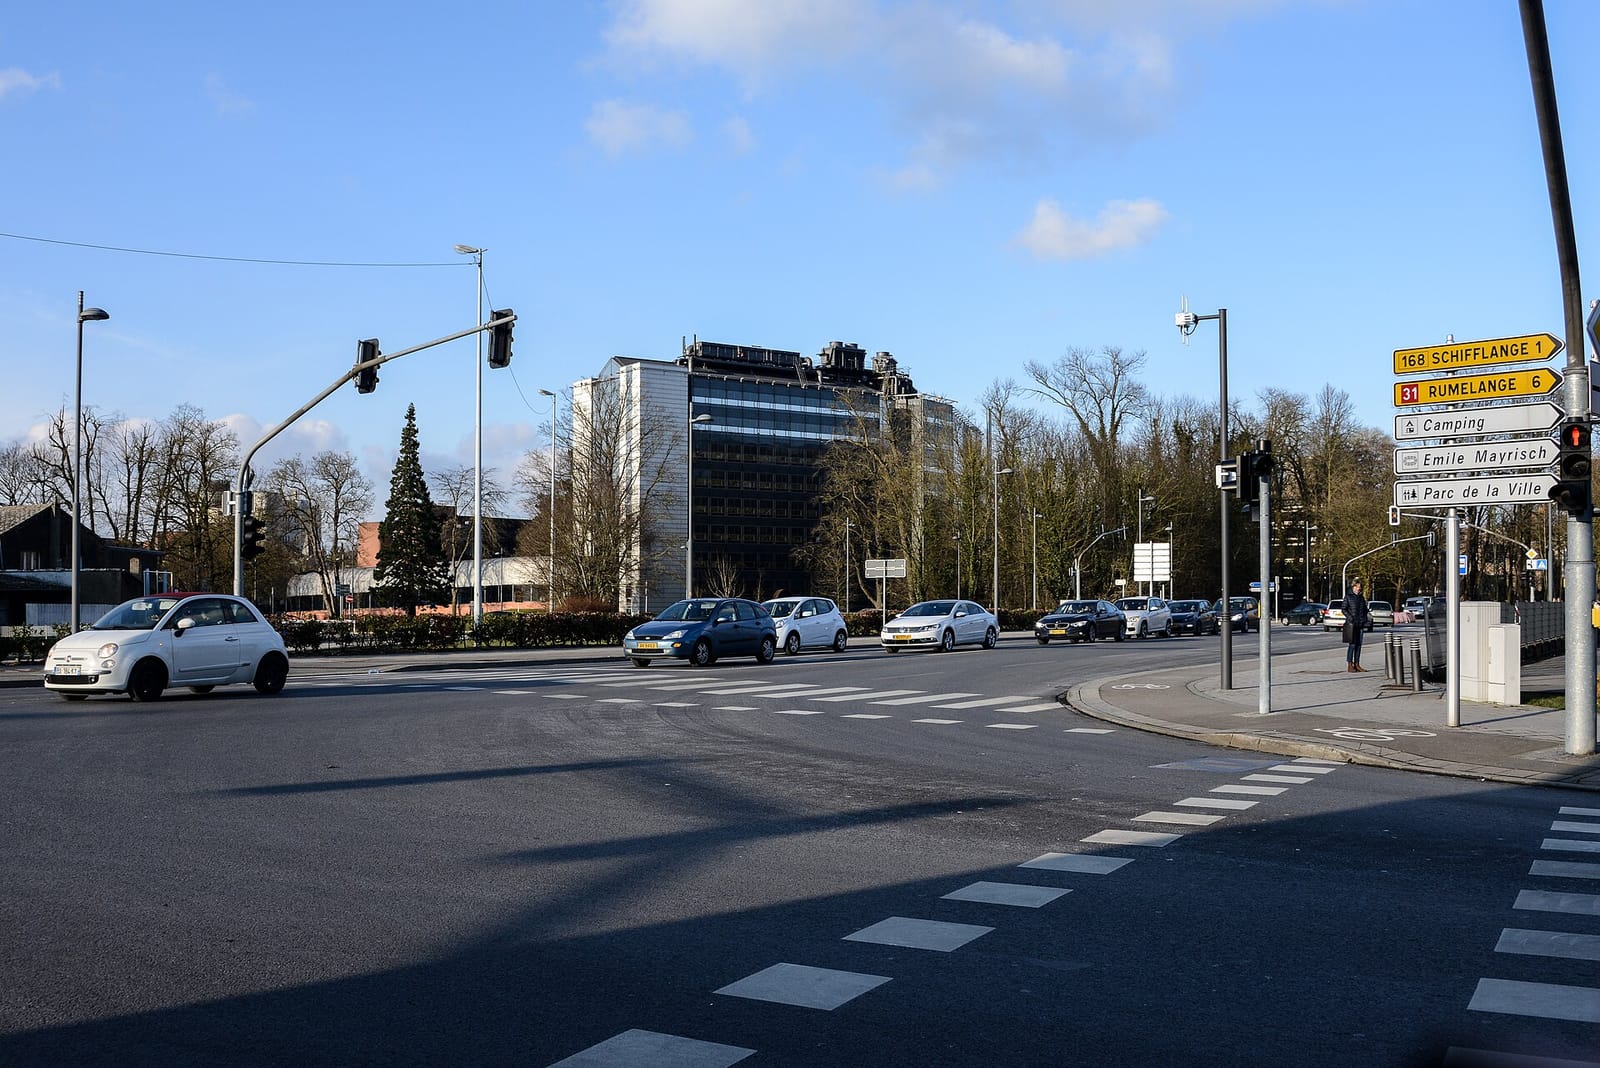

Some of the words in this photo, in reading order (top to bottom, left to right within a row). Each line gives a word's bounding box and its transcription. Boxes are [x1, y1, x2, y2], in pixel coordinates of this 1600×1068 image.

[1401, 353, 1426, 367] 168
[1432, 342, 1529, 364] SCHIFFLANGE
[1535, 341, 1542, 354] 1
[1402, 386, 1418, 401] 31
[1429, 378, 1517, 398] RUMELANGE
[1532, 375, 1541, 388] 6
[1423, 417, 1485, 432] Camping
[1423, 452, 1465, 466] Emile
[1475, 446, 1547, 464] Mayrisch
[1423, 487, 1454, 500] Parc
[1462, 485, 1479, 498] de
[1486, 484, 1499, 497] la
[1508, 482, 1541, 496] Ville
